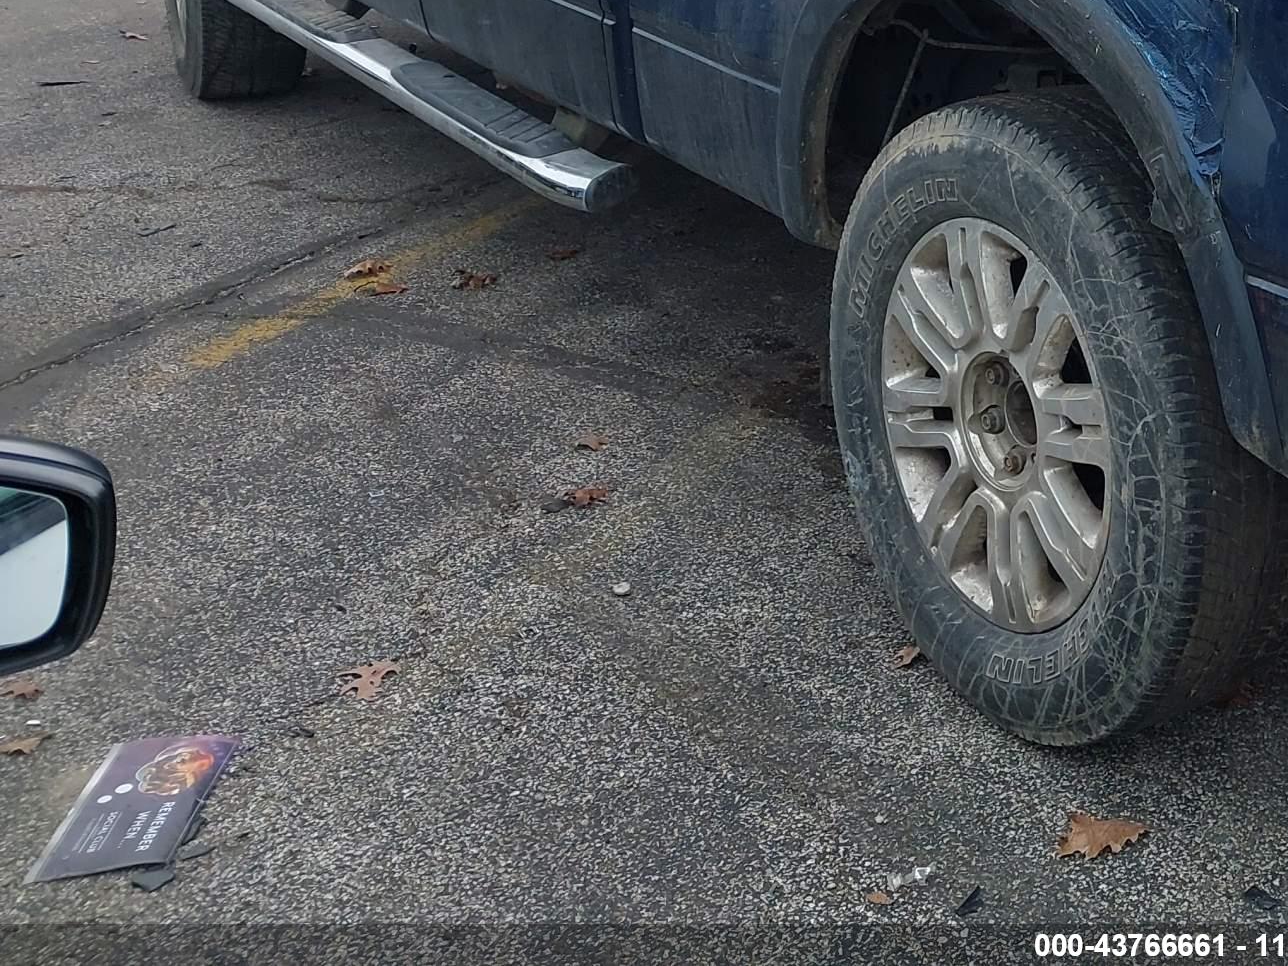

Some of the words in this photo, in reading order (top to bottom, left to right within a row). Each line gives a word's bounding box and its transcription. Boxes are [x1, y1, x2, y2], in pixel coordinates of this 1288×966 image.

[848, 178, 960, 319] MICHELIN
[99, 811, 118, 836] SOCIAL
[134, 801, 176, 852] REMEMBER
[86, 835, 104, 853] CLUB
